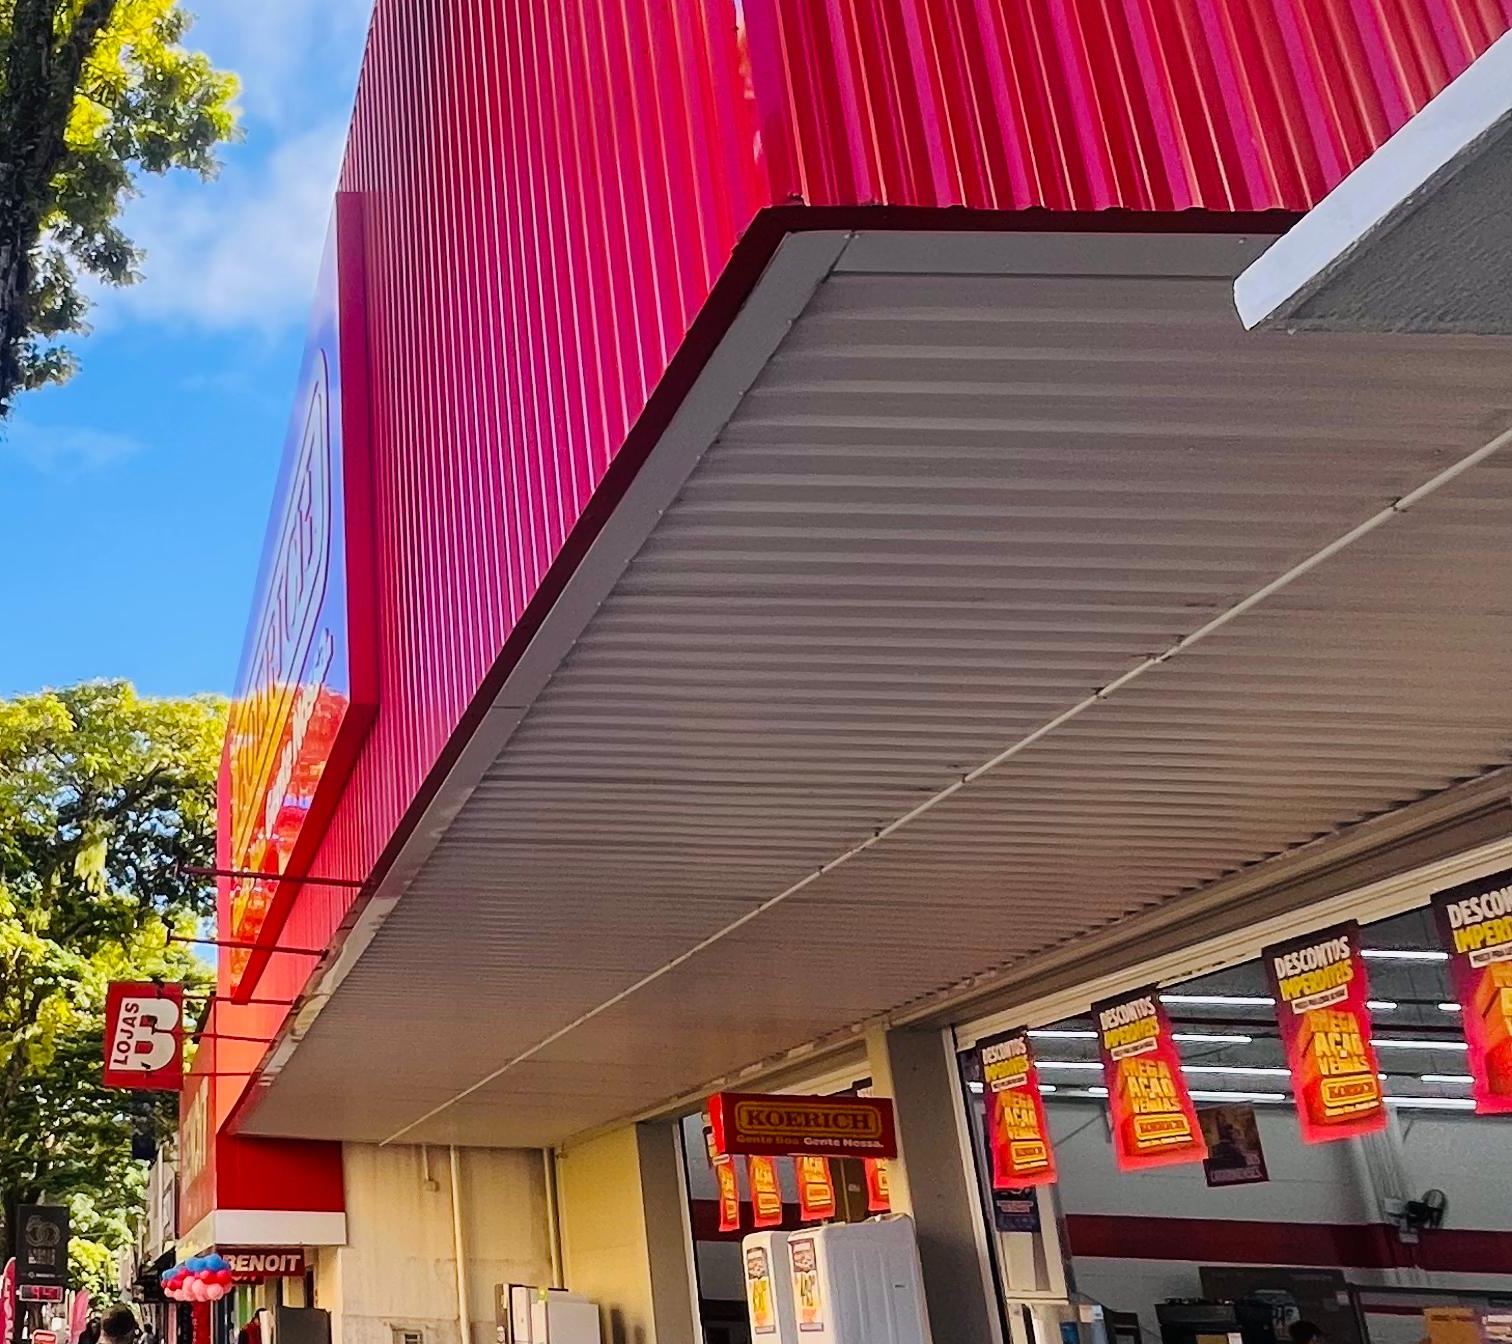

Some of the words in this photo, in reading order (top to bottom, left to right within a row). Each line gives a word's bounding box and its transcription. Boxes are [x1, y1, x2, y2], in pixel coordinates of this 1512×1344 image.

[1274, 936, 1351, 979] DESCONTOS
[109, 997, 179, 1071] B
[113, 1002, 140, 1065] LOJAS
[745, 1109, 872, 1130] KOERICH
[223, 1254, 301, 1272] BENOIT
